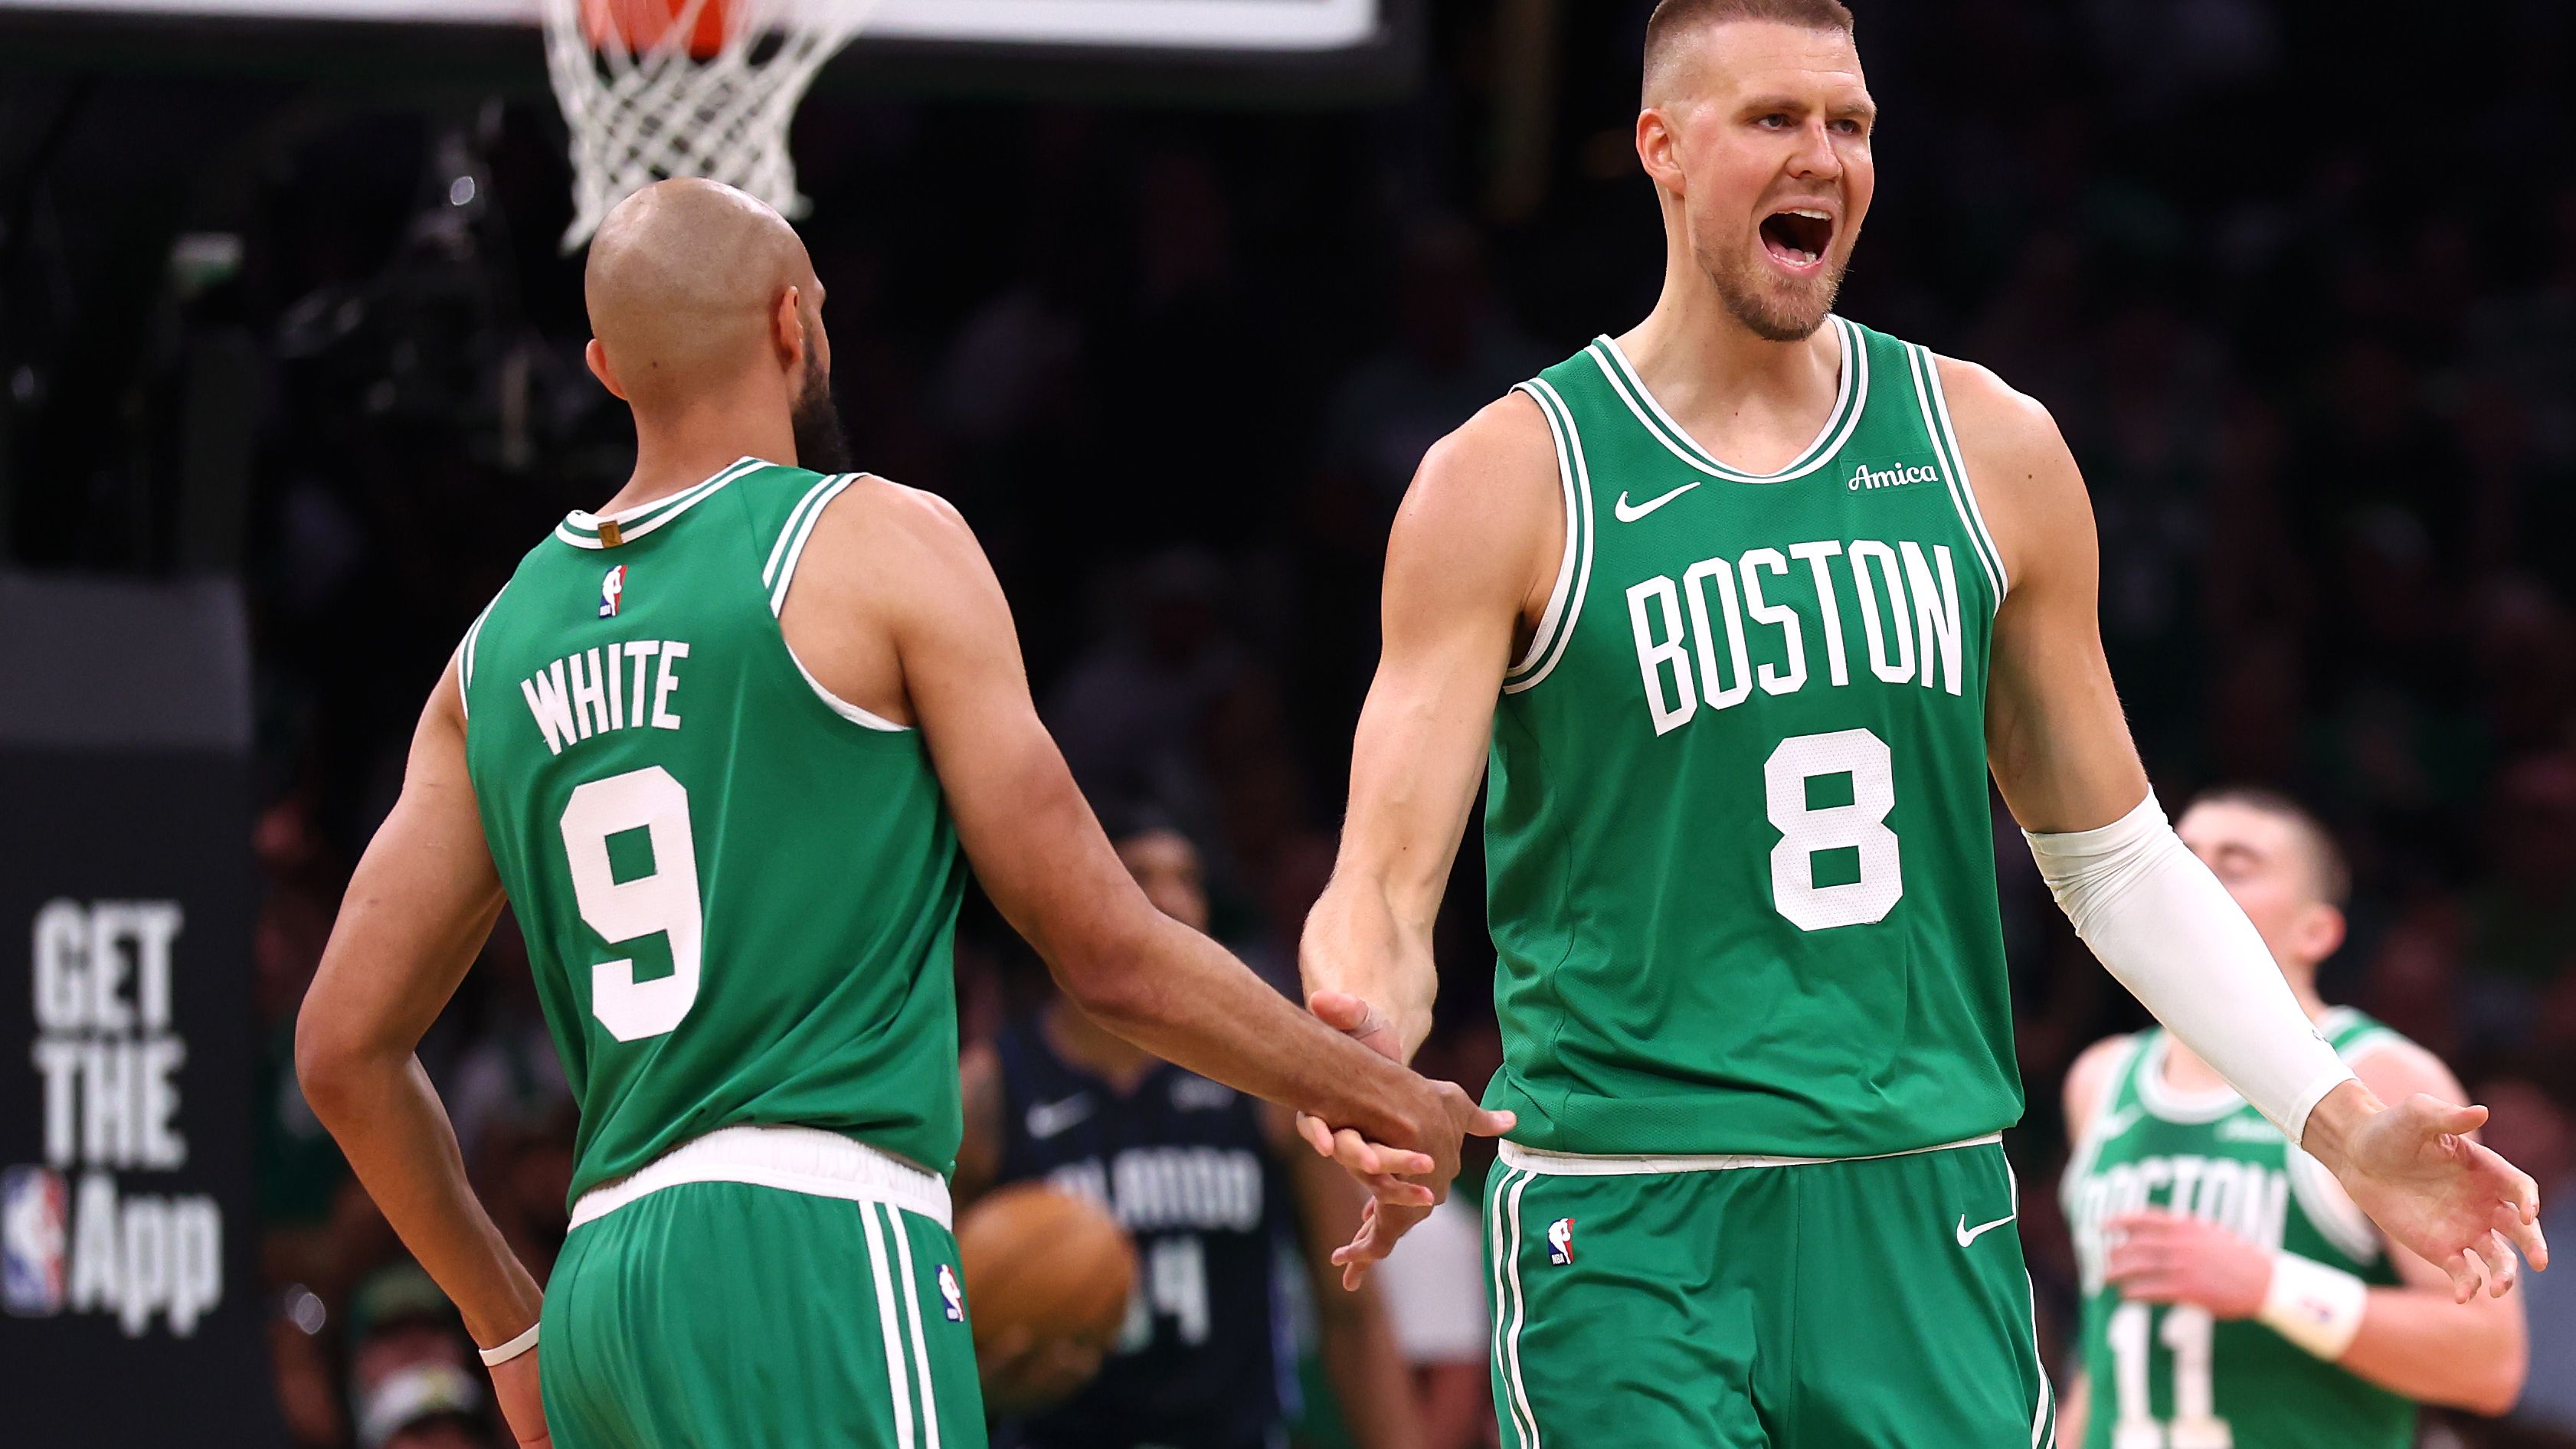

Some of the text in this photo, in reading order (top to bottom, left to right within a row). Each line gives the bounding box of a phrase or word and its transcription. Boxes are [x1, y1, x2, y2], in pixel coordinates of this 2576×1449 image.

[1848, 463, 1939, 491] Amica
[520, 639, 690, 756] WHITE
[1626, 539, 1962, 737] BOSTON
[560, 765, 702, 1042] 9
[1763, 728, 1903, 931] 8
[34, 901, 182, 1030] GET
[34, 1038, 185, 1169] THE
[71, 1172, 222, 1336] App
[2106, 1300, 2234, 1449] 11
